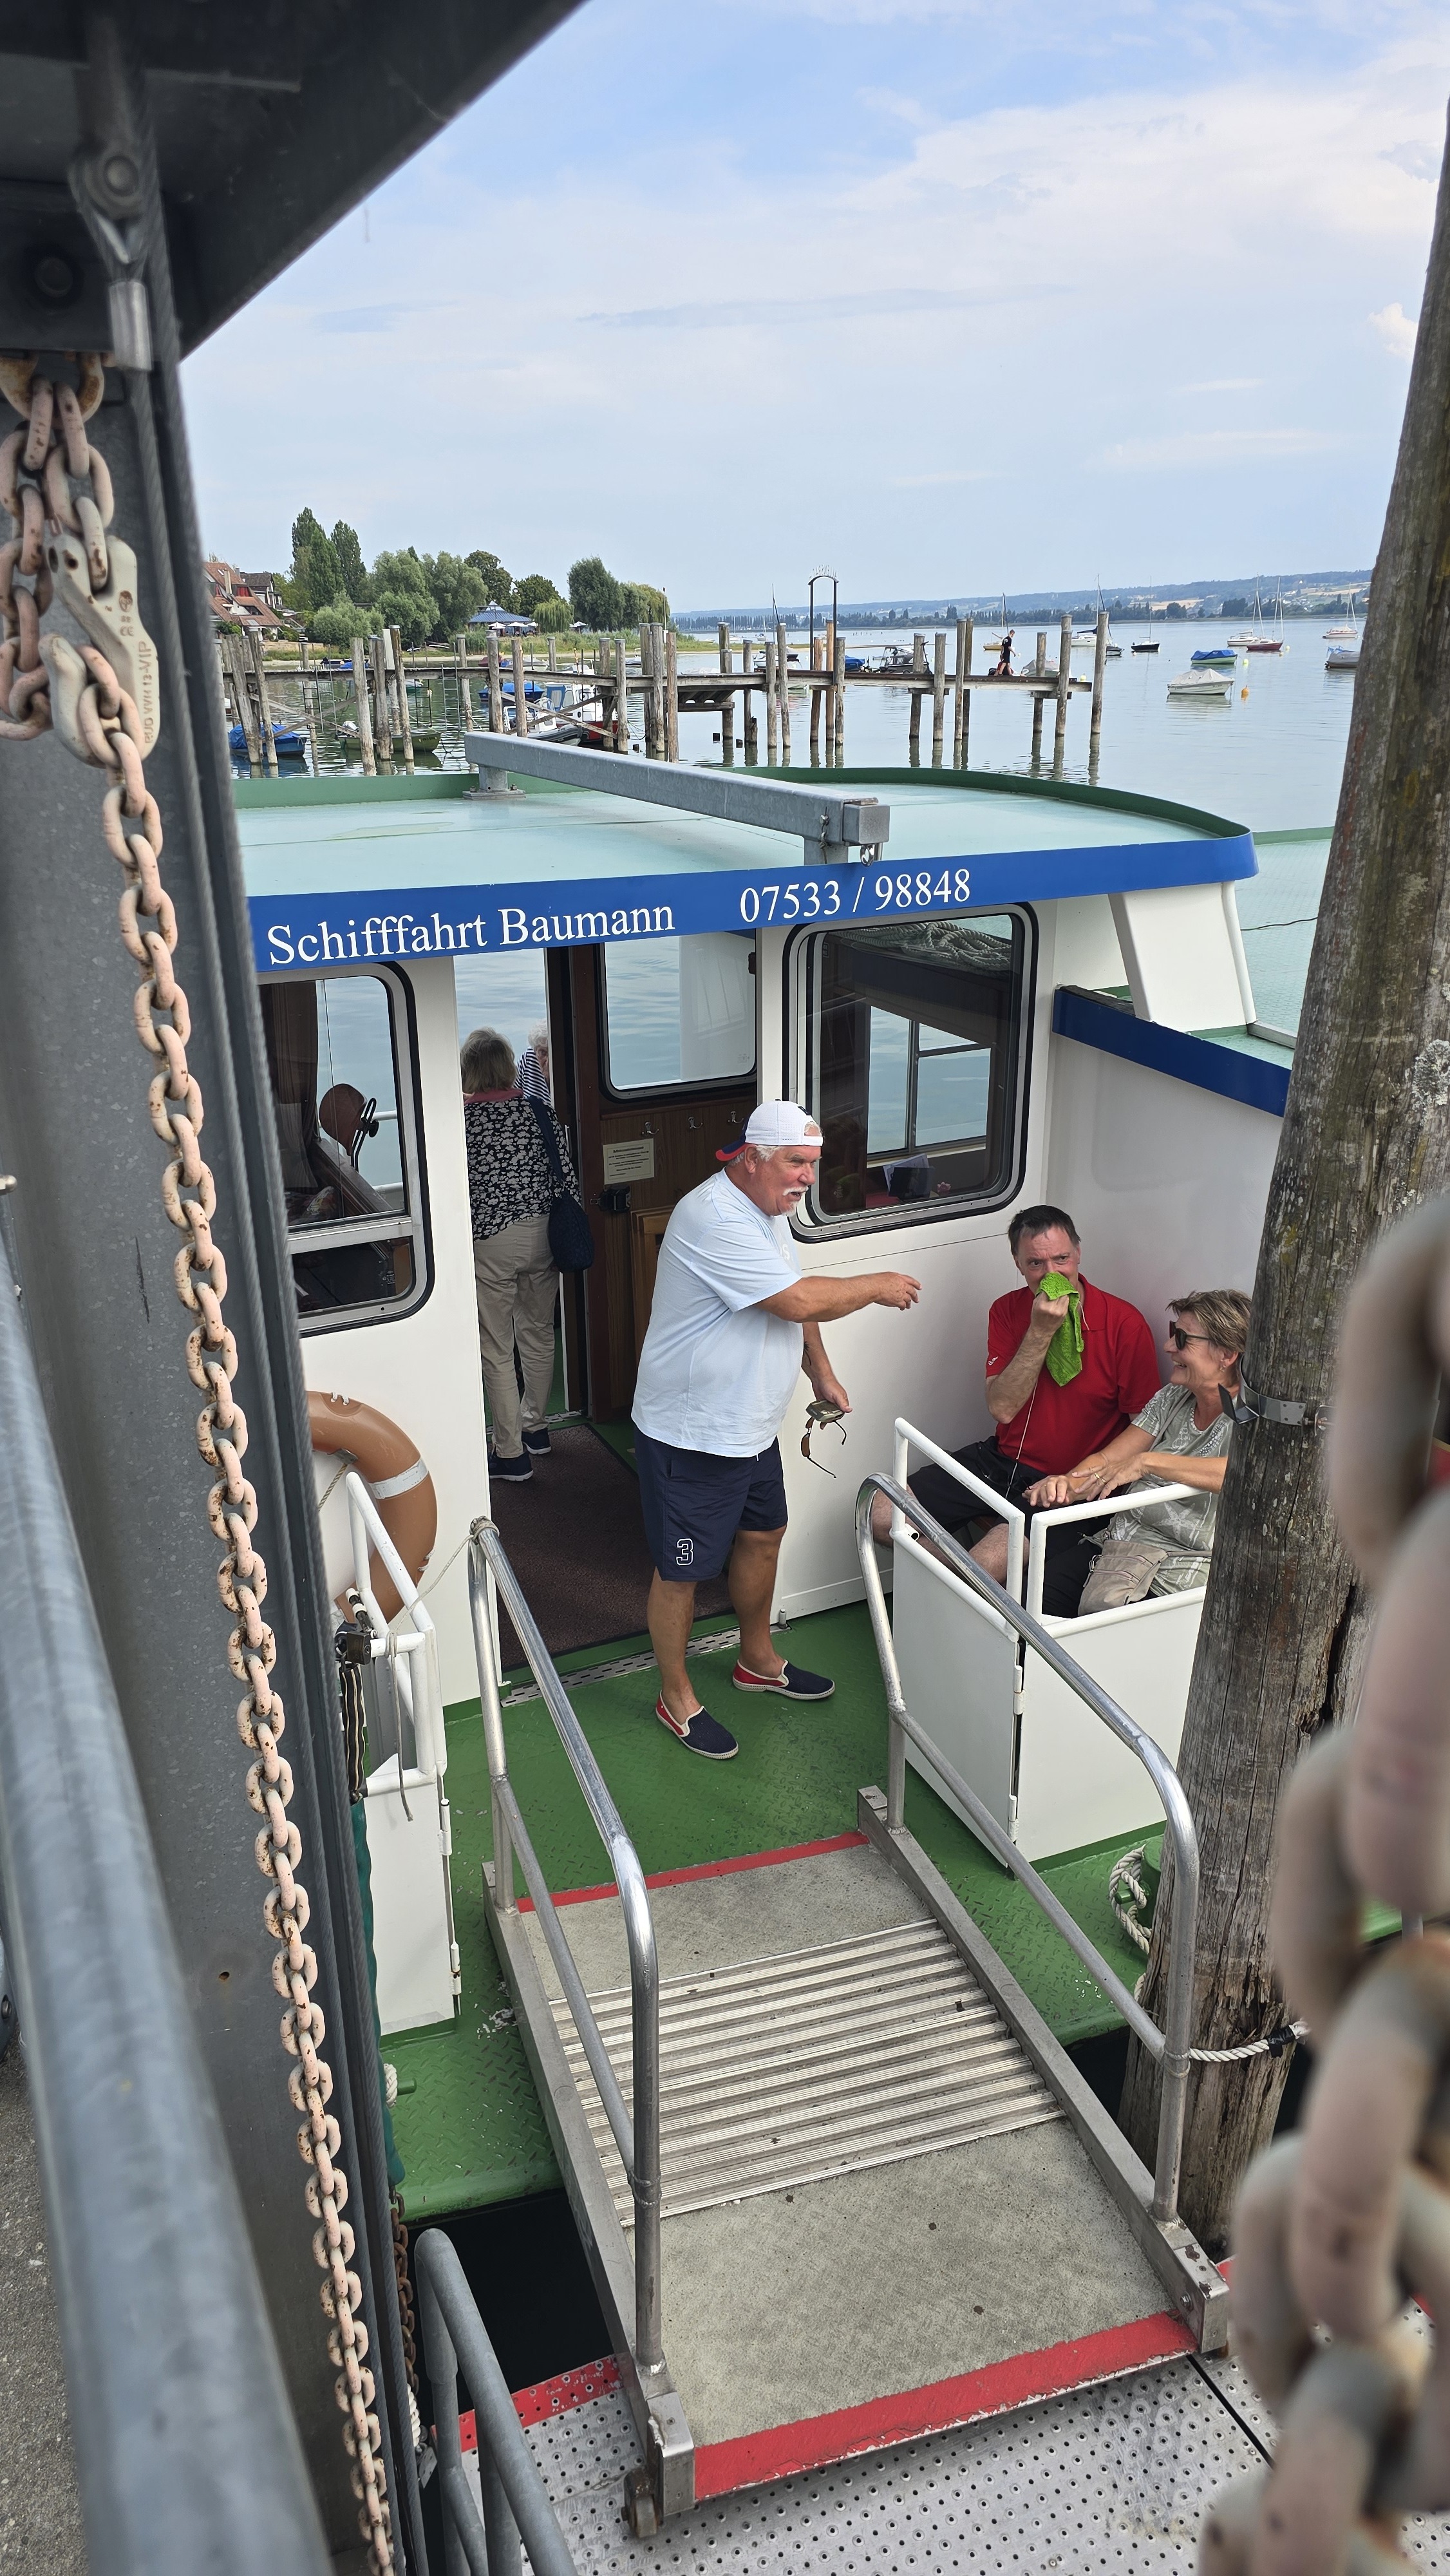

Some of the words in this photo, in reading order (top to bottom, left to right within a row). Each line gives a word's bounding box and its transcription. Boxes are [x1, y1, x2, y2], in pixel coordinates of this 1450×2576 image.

[267, 913, 487, 965] Schifffahrt
[498, 906, 675, 945] Baumann
[740, 880, 840, 922] 07533
[852, 876, 865, 913] /
[875, 868, 970, 911] 98848
[675, 1538, 693, 1566] 3
